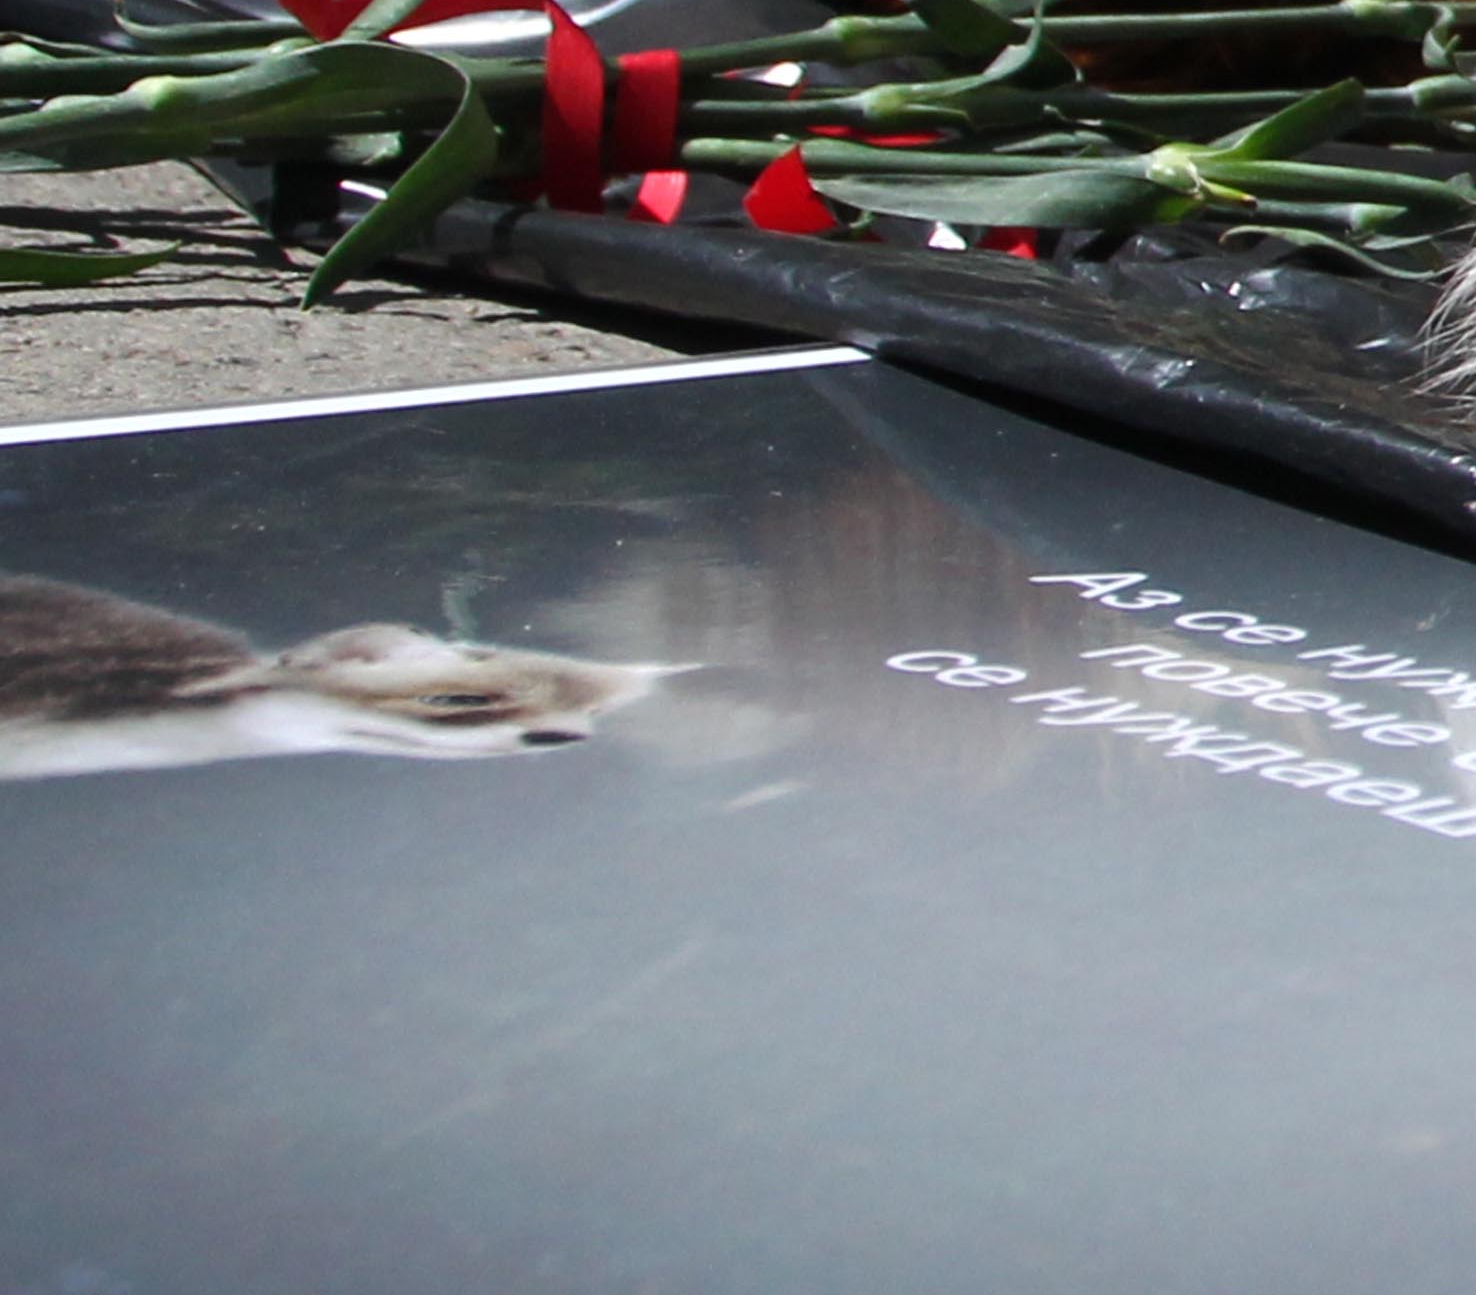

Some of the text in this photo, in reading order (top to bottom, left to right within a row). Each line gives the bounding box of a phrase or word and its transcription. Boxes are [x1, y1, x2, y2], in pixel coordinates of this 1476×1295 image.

[1029, 567, 1182, 611] Аз
[1173, 606, 1309, 646] се
[884, 648, 1029, 689] се
[1079, 641, 1451, 748] повече
